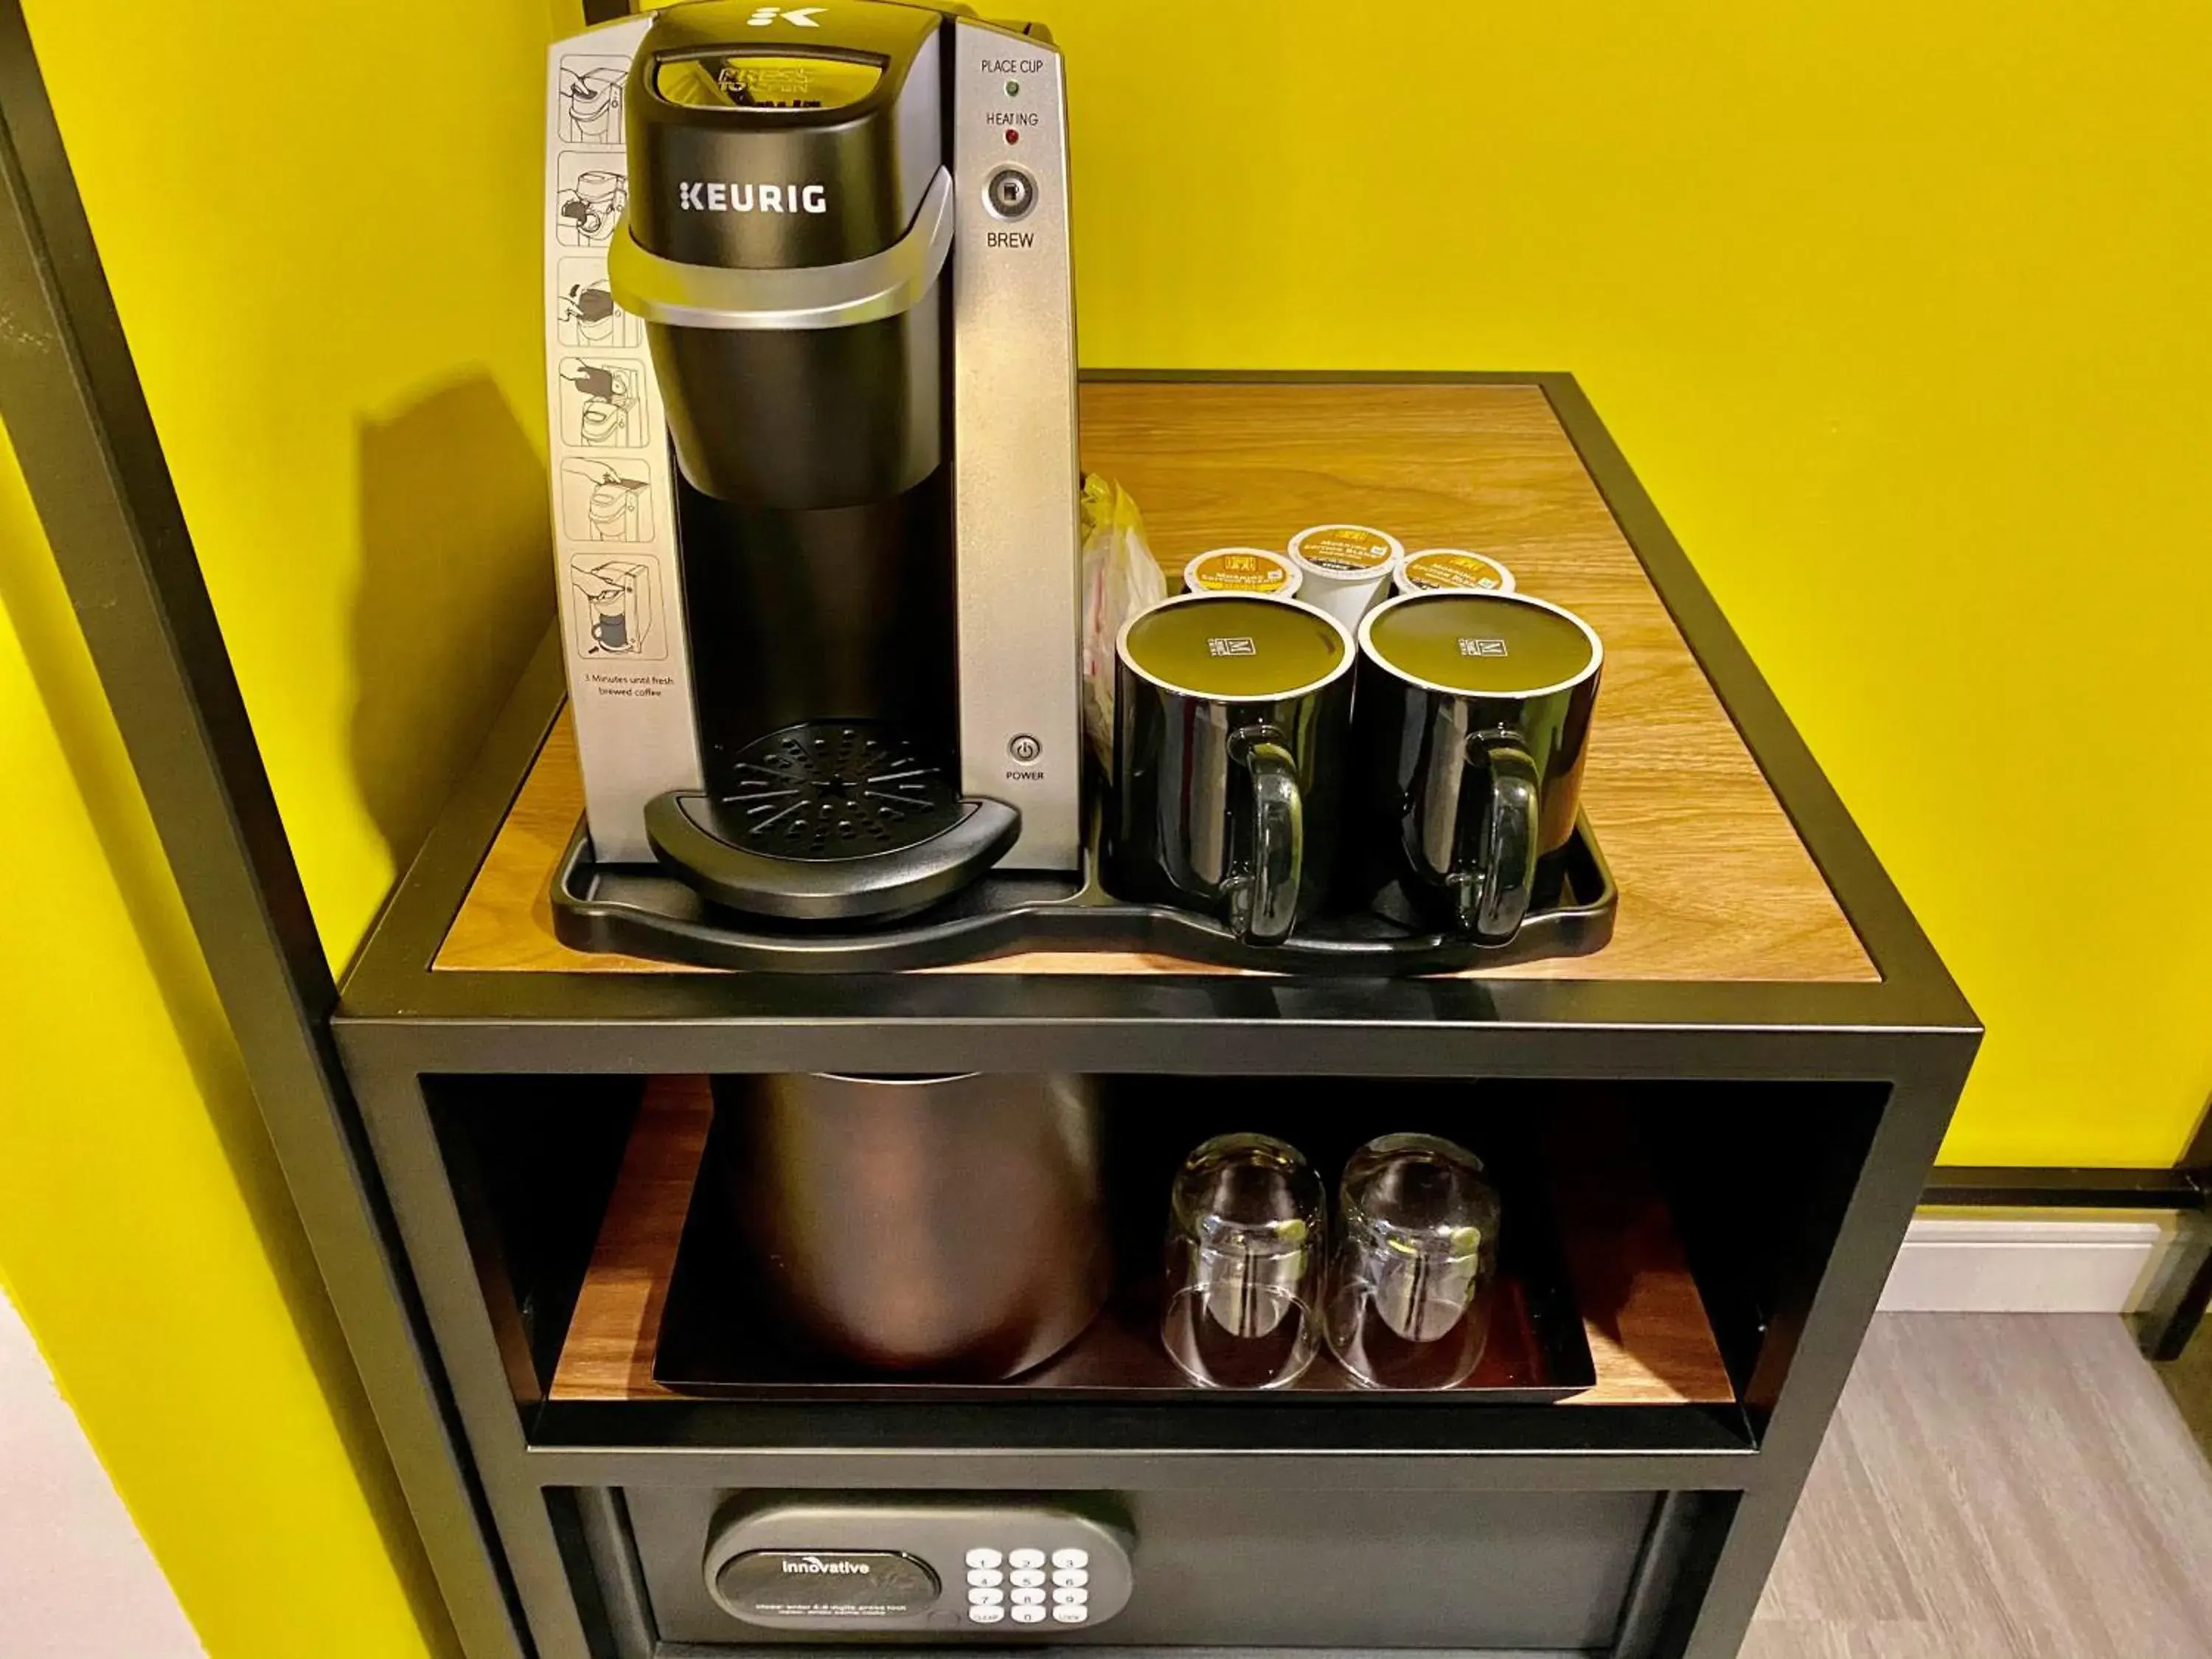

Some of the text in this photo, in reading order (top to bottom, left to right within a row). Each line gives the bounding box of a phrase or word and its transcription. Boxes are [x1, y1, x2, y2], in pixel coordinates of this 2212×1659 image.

[981, 60, 1043, 73] PLACE CUP
[986, 113, 1038, 126] HEATING
[679, 181, 827, 213] KEURIG
[987, 232, 1034, 248] BREW
[592, 675, 627, 684] Minutes
[629, 675, 650, 684] until
[652, 676, 674, 685] fresh
[598, 686, 661, 697] brewed coffee
[1006, 771, 1044, 780] POWER
